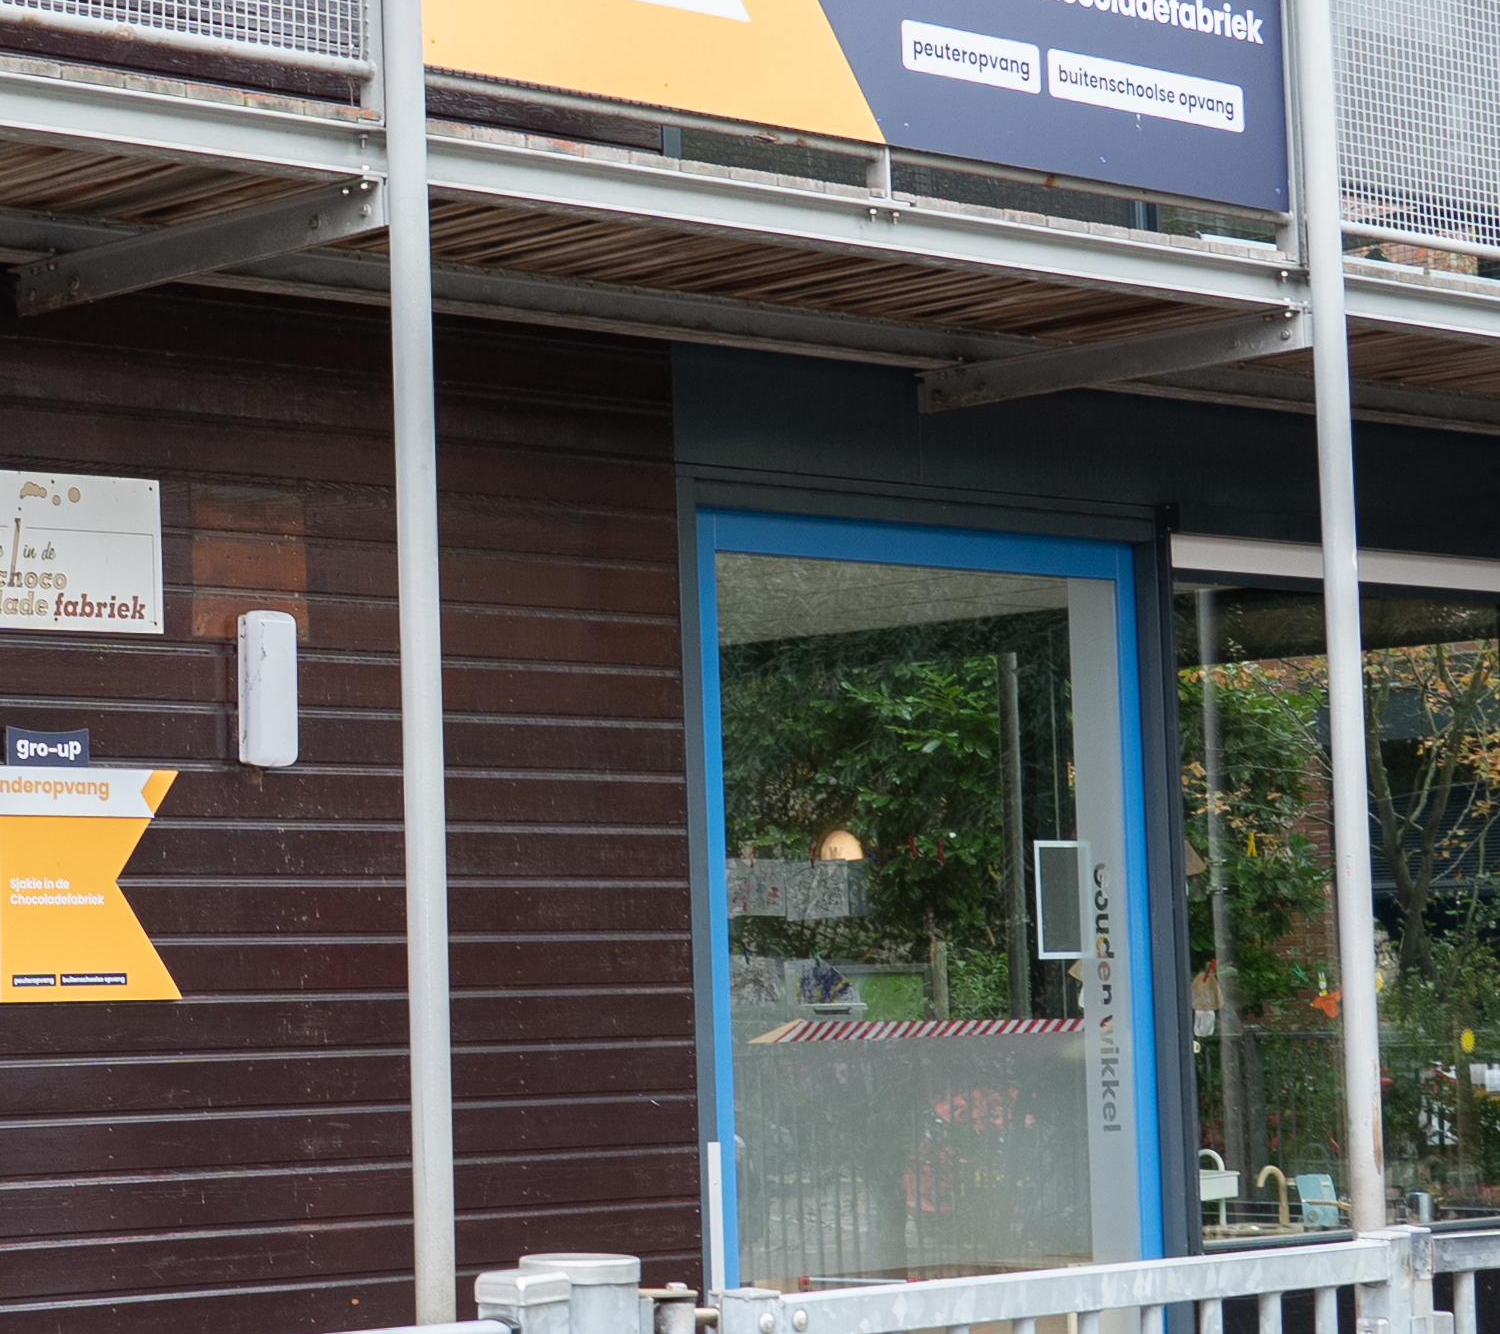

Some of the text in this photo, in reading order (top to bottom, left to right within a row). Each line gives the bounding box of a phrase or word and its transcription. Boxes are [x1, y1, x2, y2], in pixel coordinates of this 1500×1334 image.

[913, 40, 1030, 81] peuteropvang
[1058, 64, 1234, 120] buitenschoolse opvang
[23, 543, 37, 560] in
[41, 541, 57, 561] de
[16, 739, 82, 761] gro-up
[9, 877, 70, 892] Sjakie in de
[9, 893, 105, 905] Chocoladefabriek
